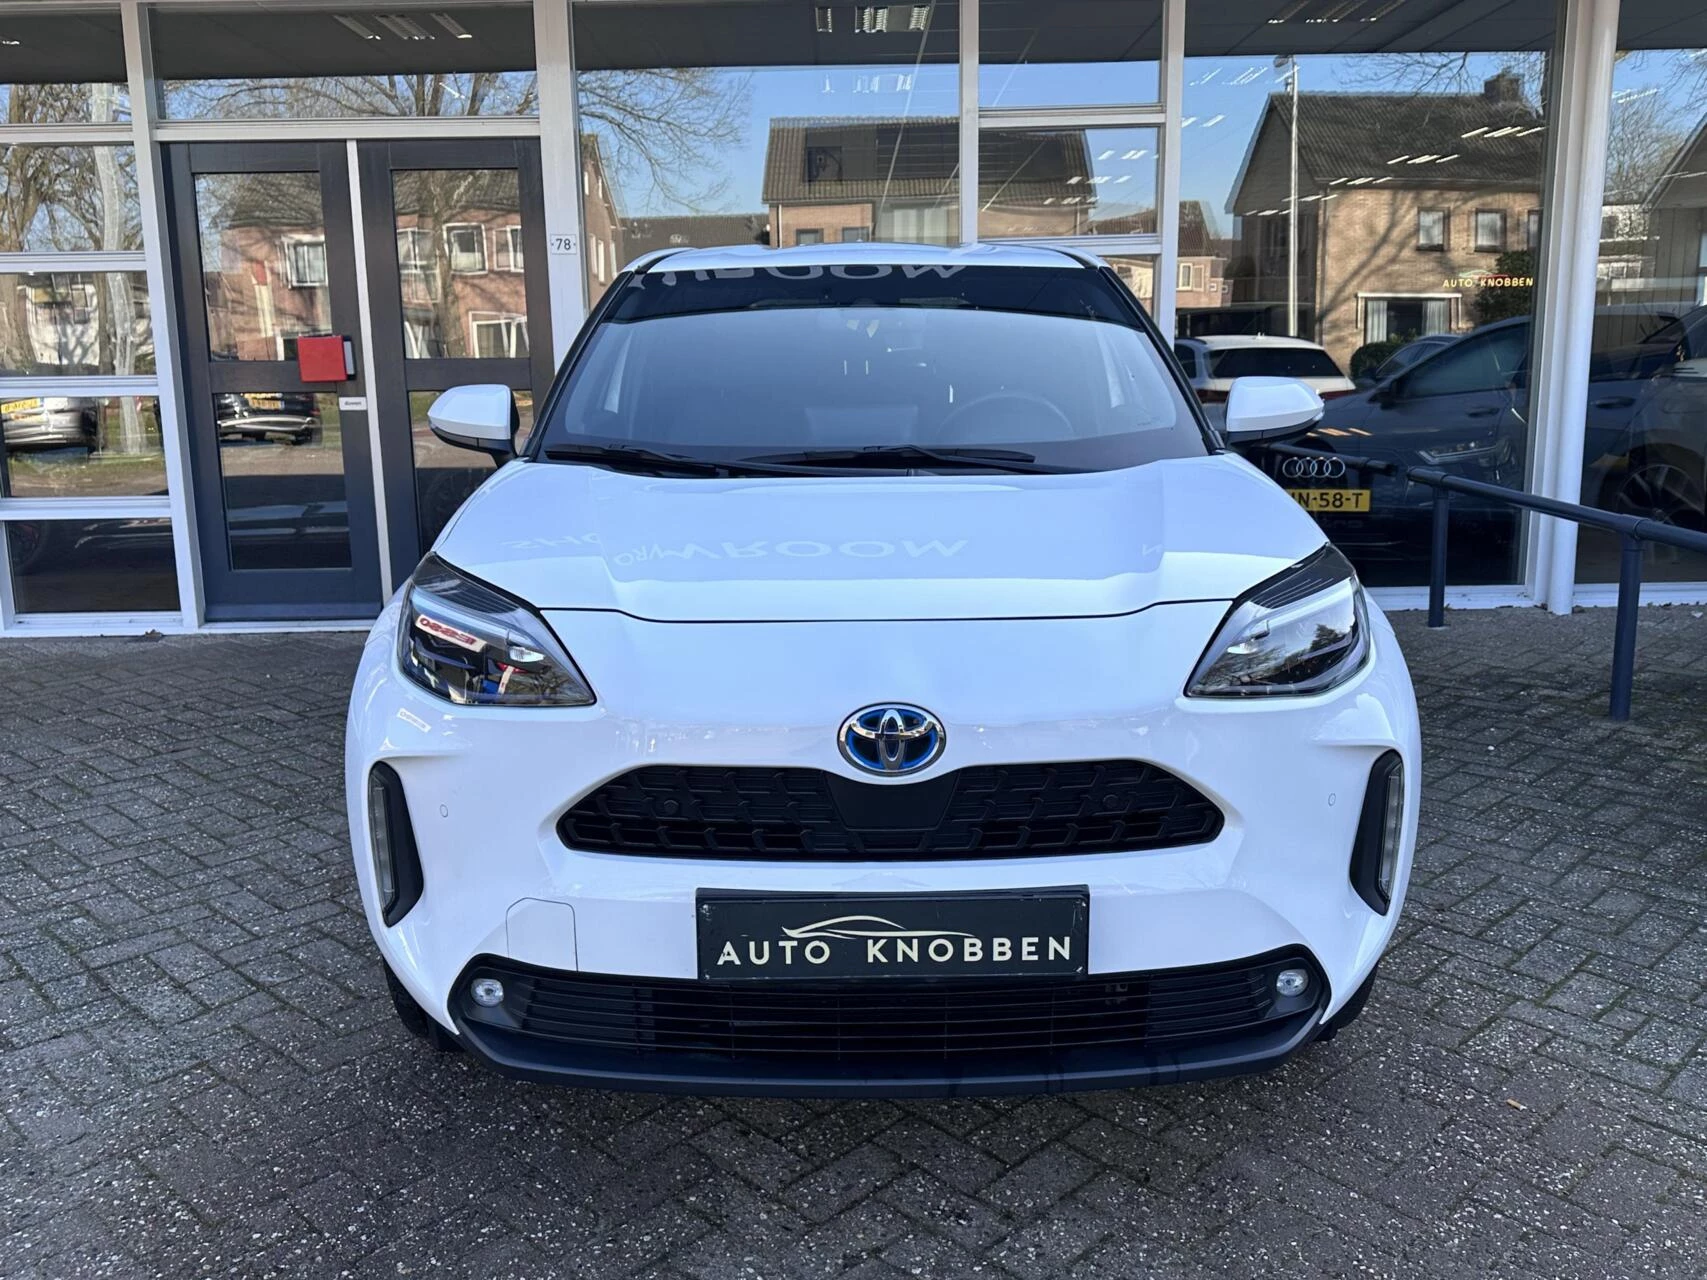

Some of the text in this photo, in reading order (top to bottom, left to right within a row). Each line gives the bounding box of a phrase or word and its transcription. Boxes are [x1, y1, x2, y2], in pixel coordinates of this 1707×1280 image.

[555, 238, 571, 250] 78
[1443, 277, 1534, 288] AUTO KNOBBEN
[716, 935, 1071, 966] AUTO KNOBBEN
